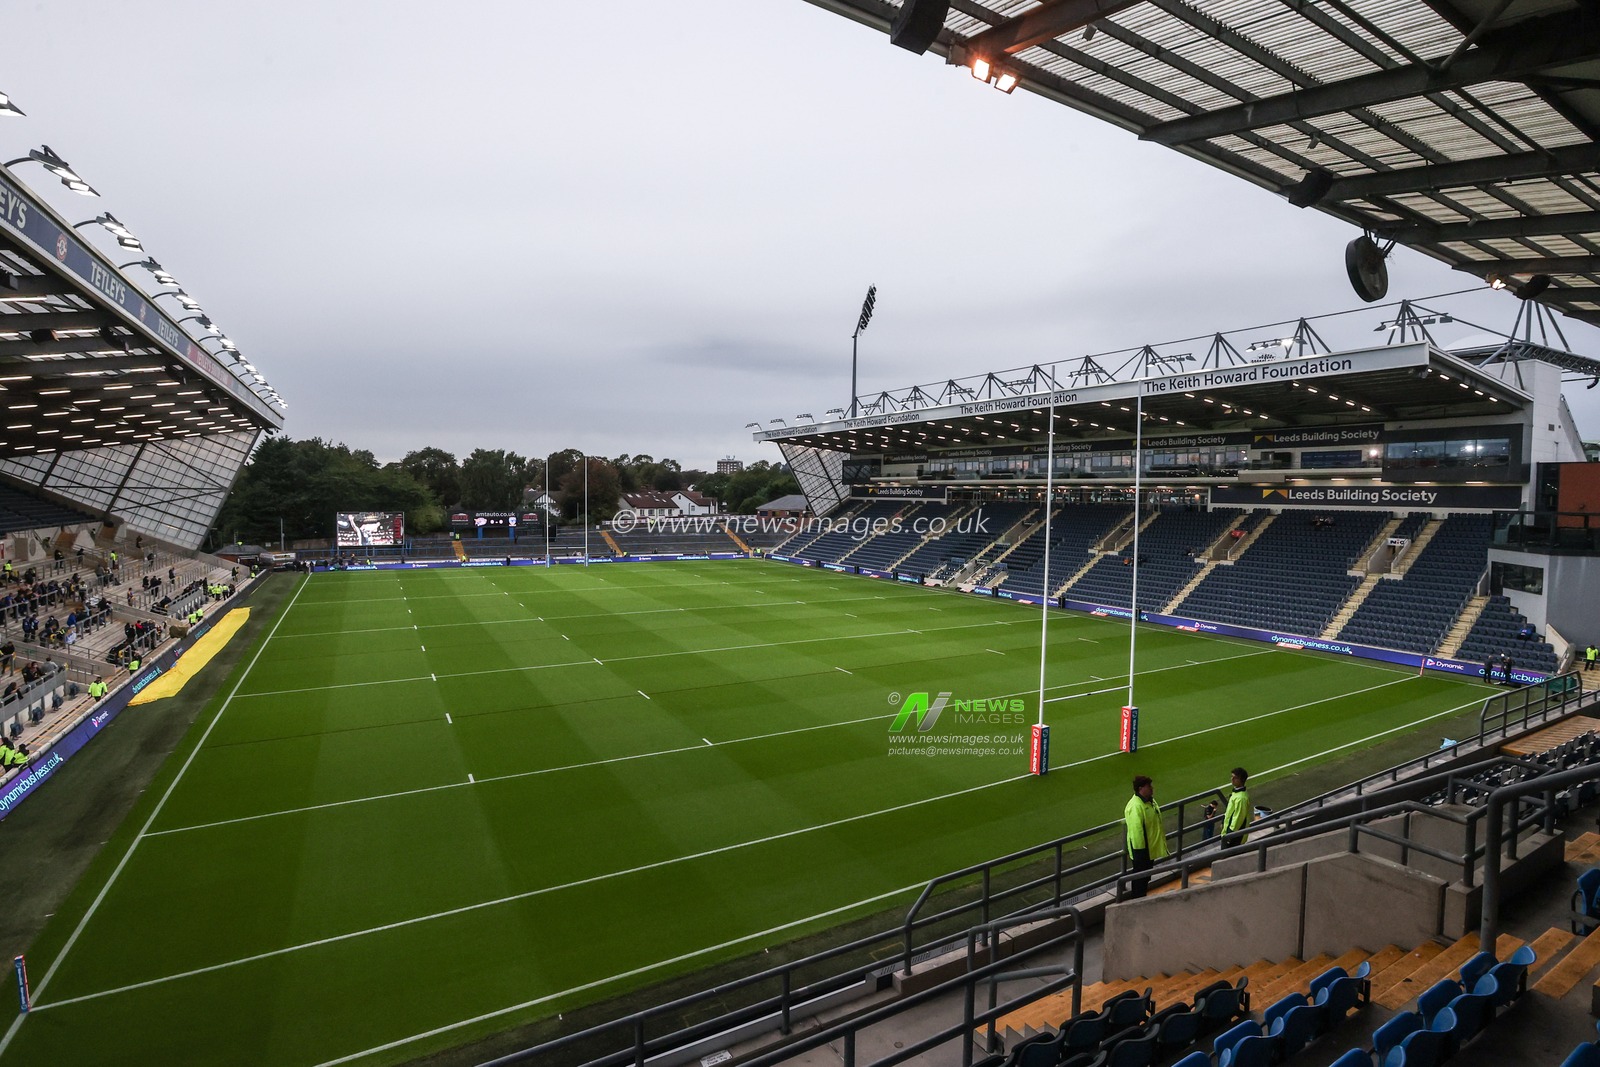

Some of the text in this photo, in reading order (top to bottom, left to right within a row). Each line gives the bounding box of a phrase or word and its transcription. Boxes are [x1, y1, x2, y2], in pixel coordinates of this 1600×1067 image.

[91, 260, 126, 305] TETLEY'S
[1144, 358, 1352, 393] The Keith Howard Foundation
[960, 405, 973, 415] The
[974, 402, 994, 413] Keith
[995, 398, 1026, 410] Howard
[844, 413, 920, 429] The Keith Howard Foundation
[781, 428, 795, 437] Howard
[795, 426, 818, 435] Foundation
[1273, 430, 1380, 443] Leeds Building Society
[1052, 444, 1070, 453] uilding
[1071, 443, 1092, 452] Society
[1147, 435, 1226, 448] Leeds Building Society
[960, 449, 976, 457] Building
[976, 448, 992, 457] Society
[889, 487, 906, 496] Building
[906, 488, 924, 497] Society
[1289, 489, 1437, 504] Leeds Building Society
[1200, 623, 1217, 632] Dynamic
[1271, 634, 1351, 653] dynamicbusiness.co.uk
[1436, 661, 1464, 671] Dynamic
